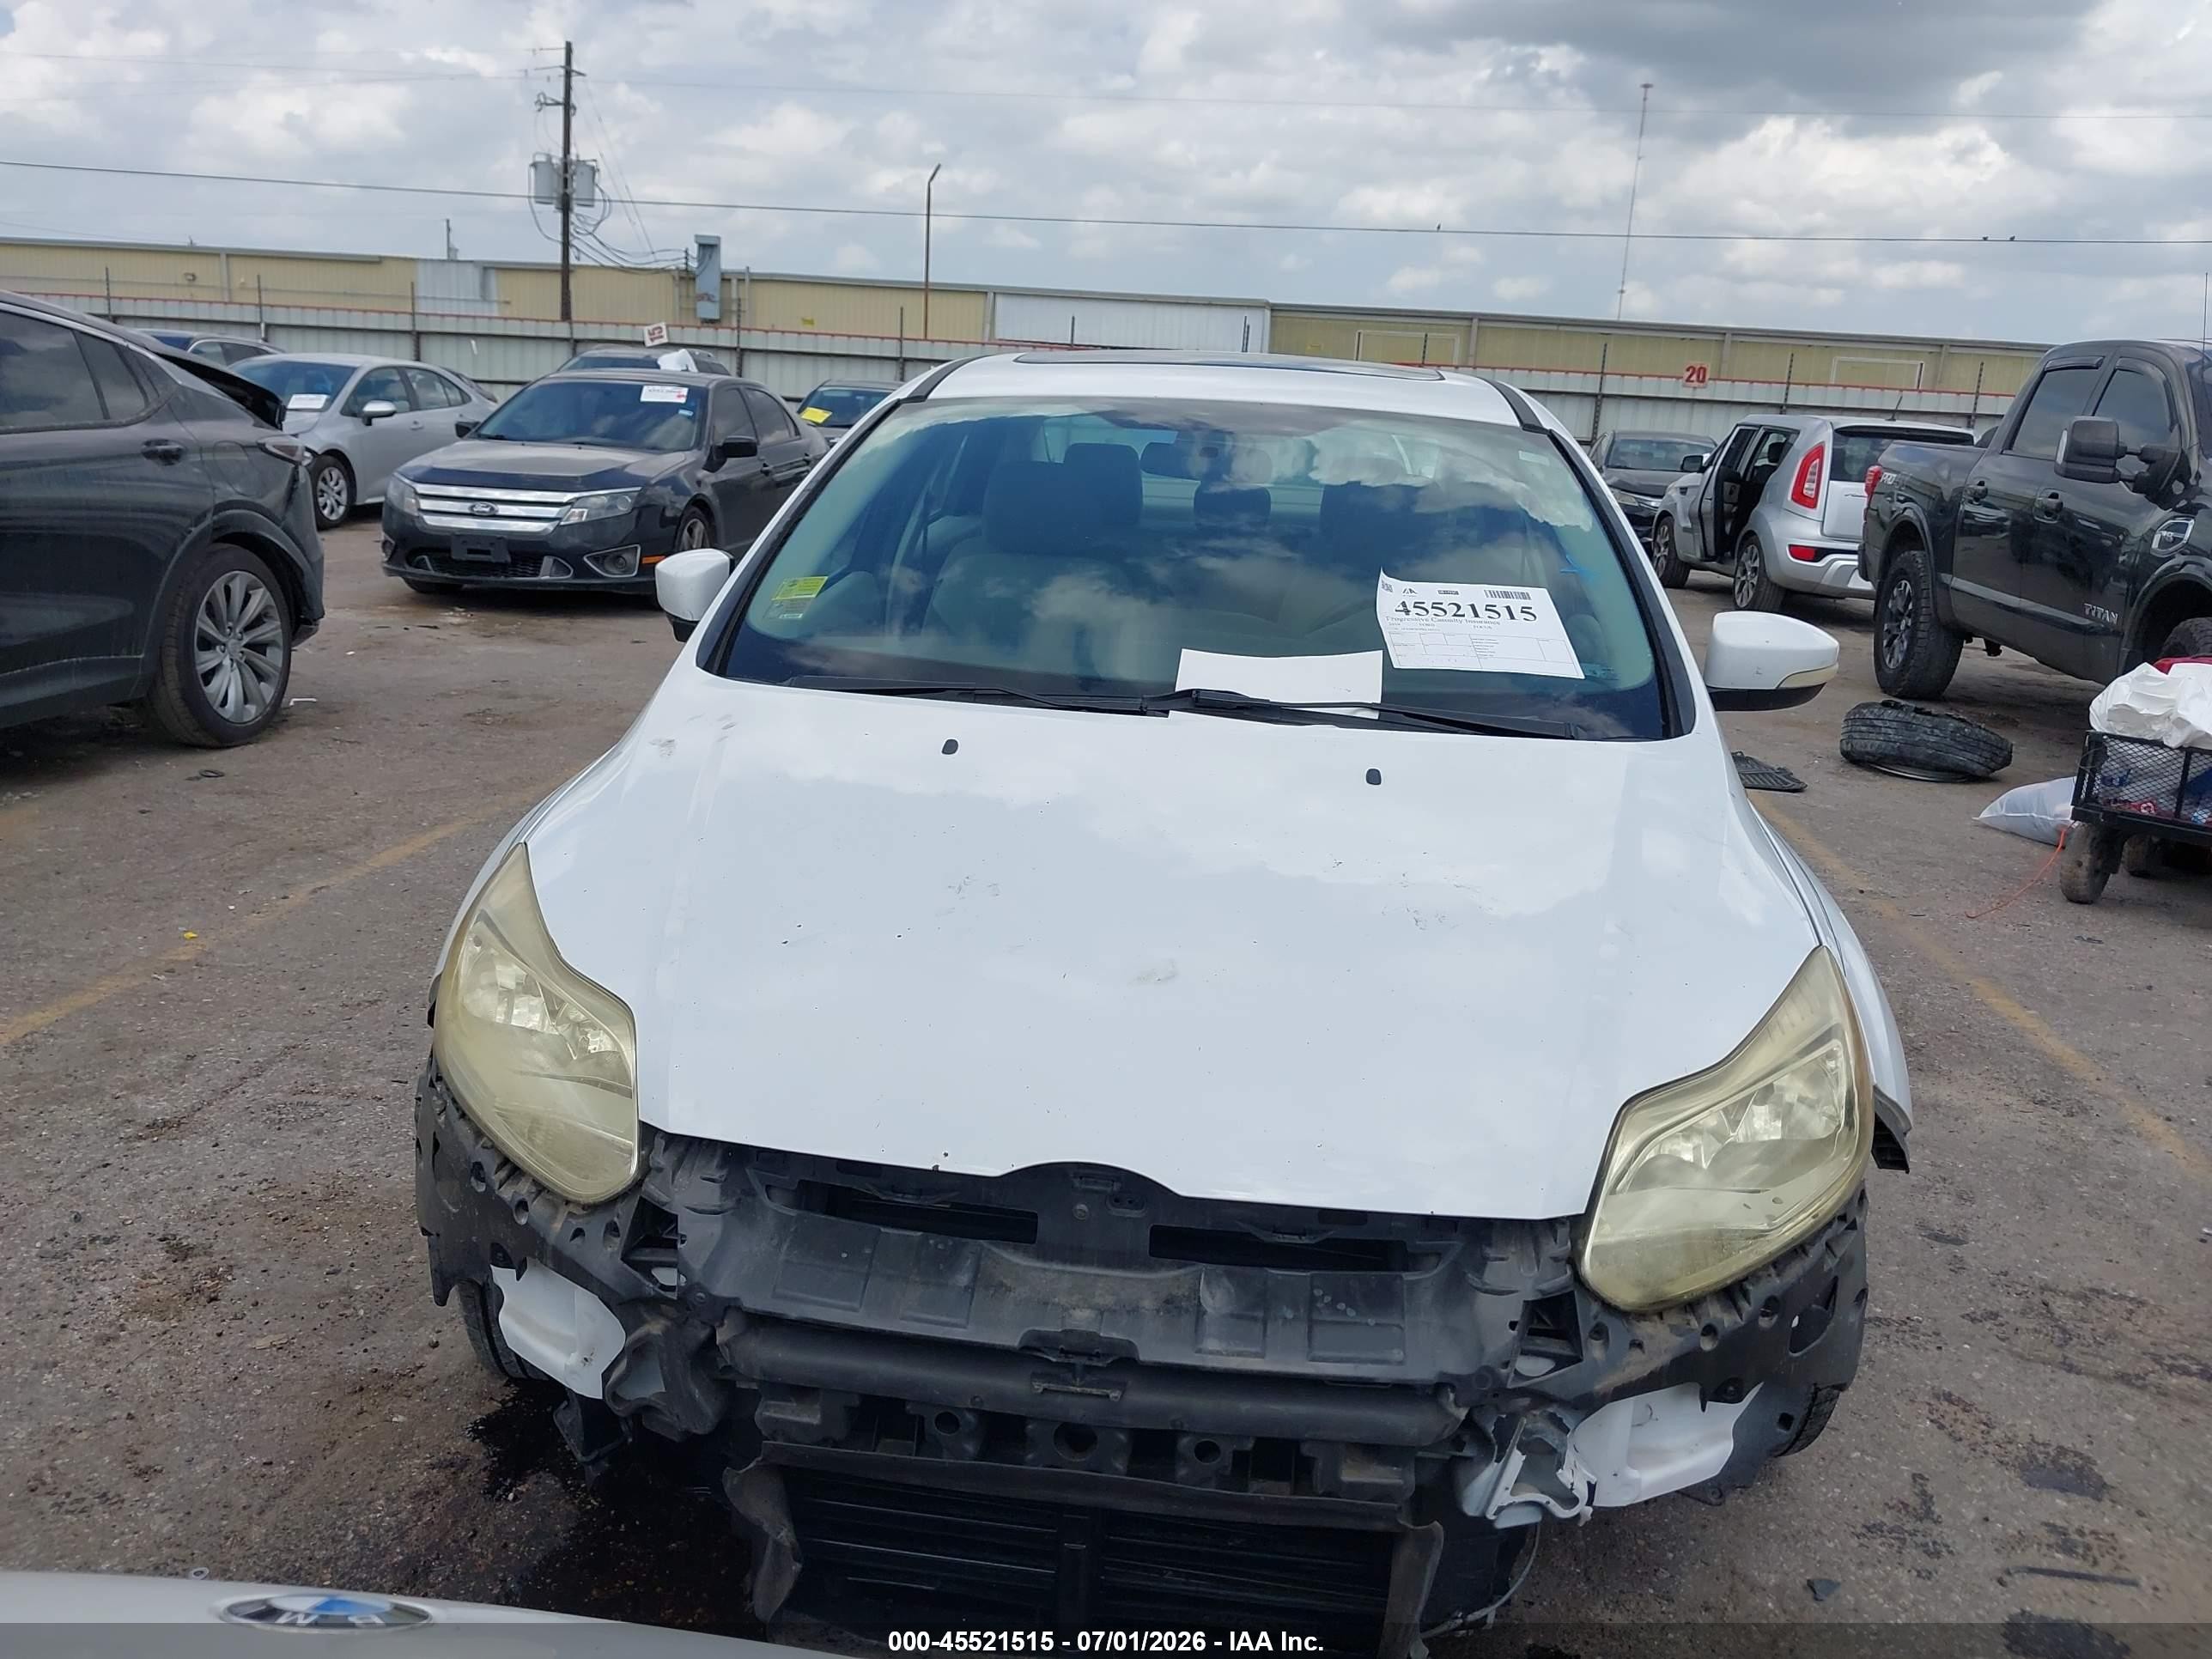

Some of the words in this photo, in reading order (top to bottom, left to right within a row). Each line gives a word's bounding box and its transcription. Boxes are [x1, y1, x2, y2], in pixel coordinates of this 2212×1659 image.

[648, 326, 664, 343] 15
[1686, 366, 1707, 383] 20
[1395, 600, 1537, 622] 45521515
[2084, 603, 2118, 624] TITAN
